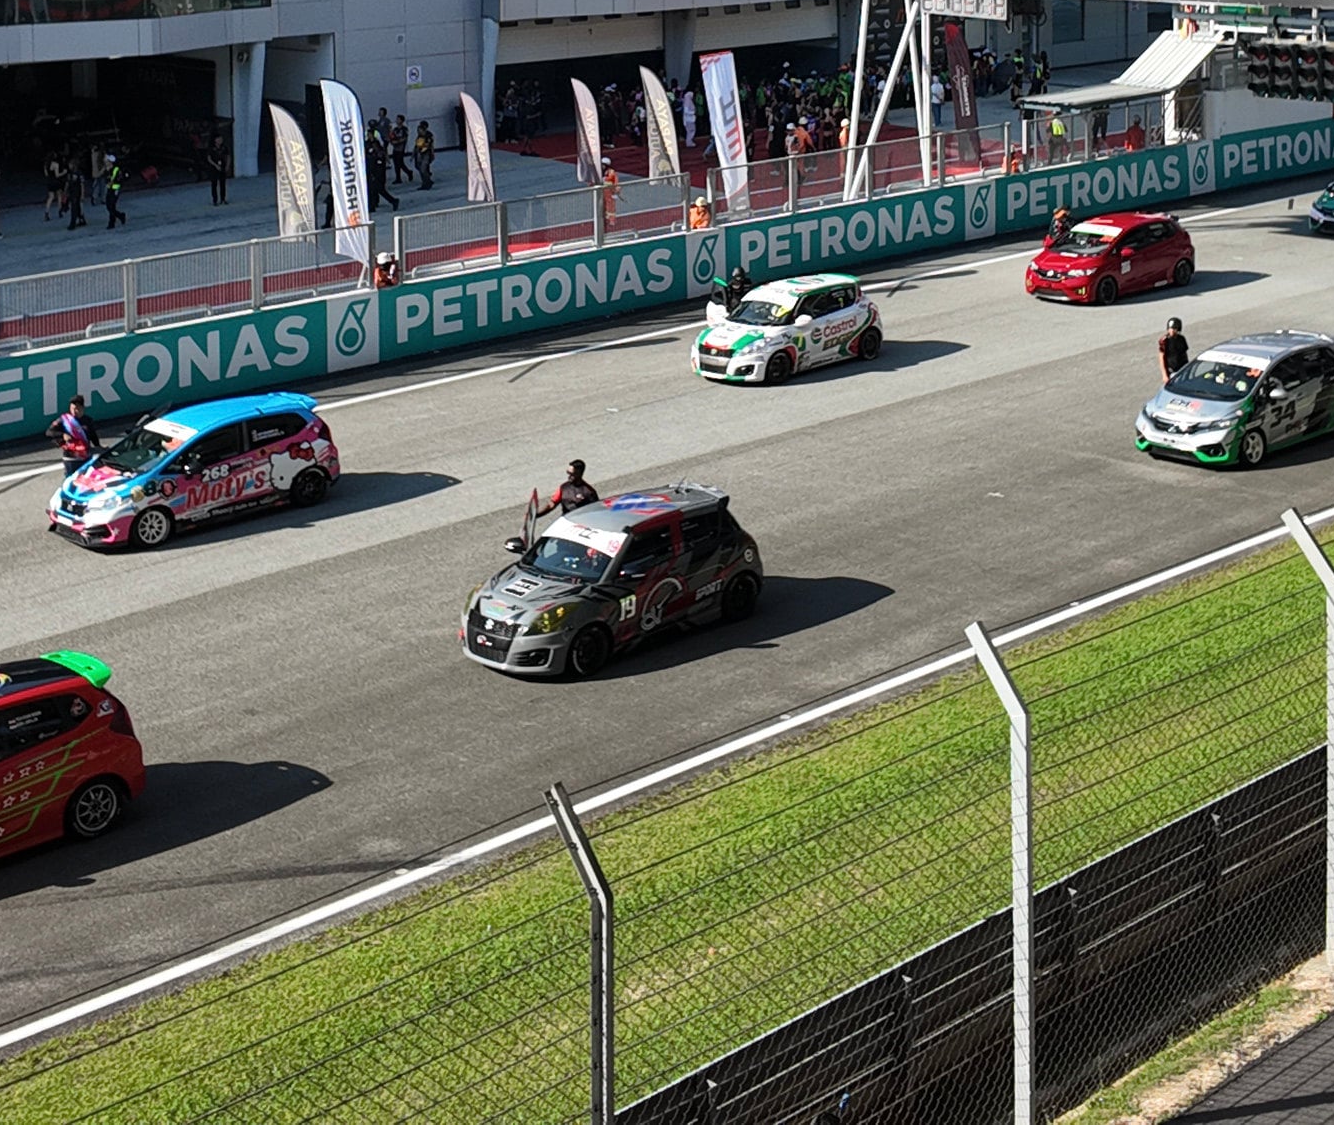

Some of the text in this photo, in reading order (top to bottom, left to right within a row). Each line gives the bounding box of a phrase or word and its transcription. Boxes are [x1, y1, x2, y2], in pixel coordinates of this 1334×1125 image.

[1006, 155, 1180, 220] PETRONAS
[740, 195, 956, 272] PETRONAS
[395, 248, 674, 344] PETRONAS
[823, 316, 858, 339] Castrol
[185, 470, 267, 510] Moty's
[202, 464, 230, 483] 268
[619, 594, 637, 622] 19
